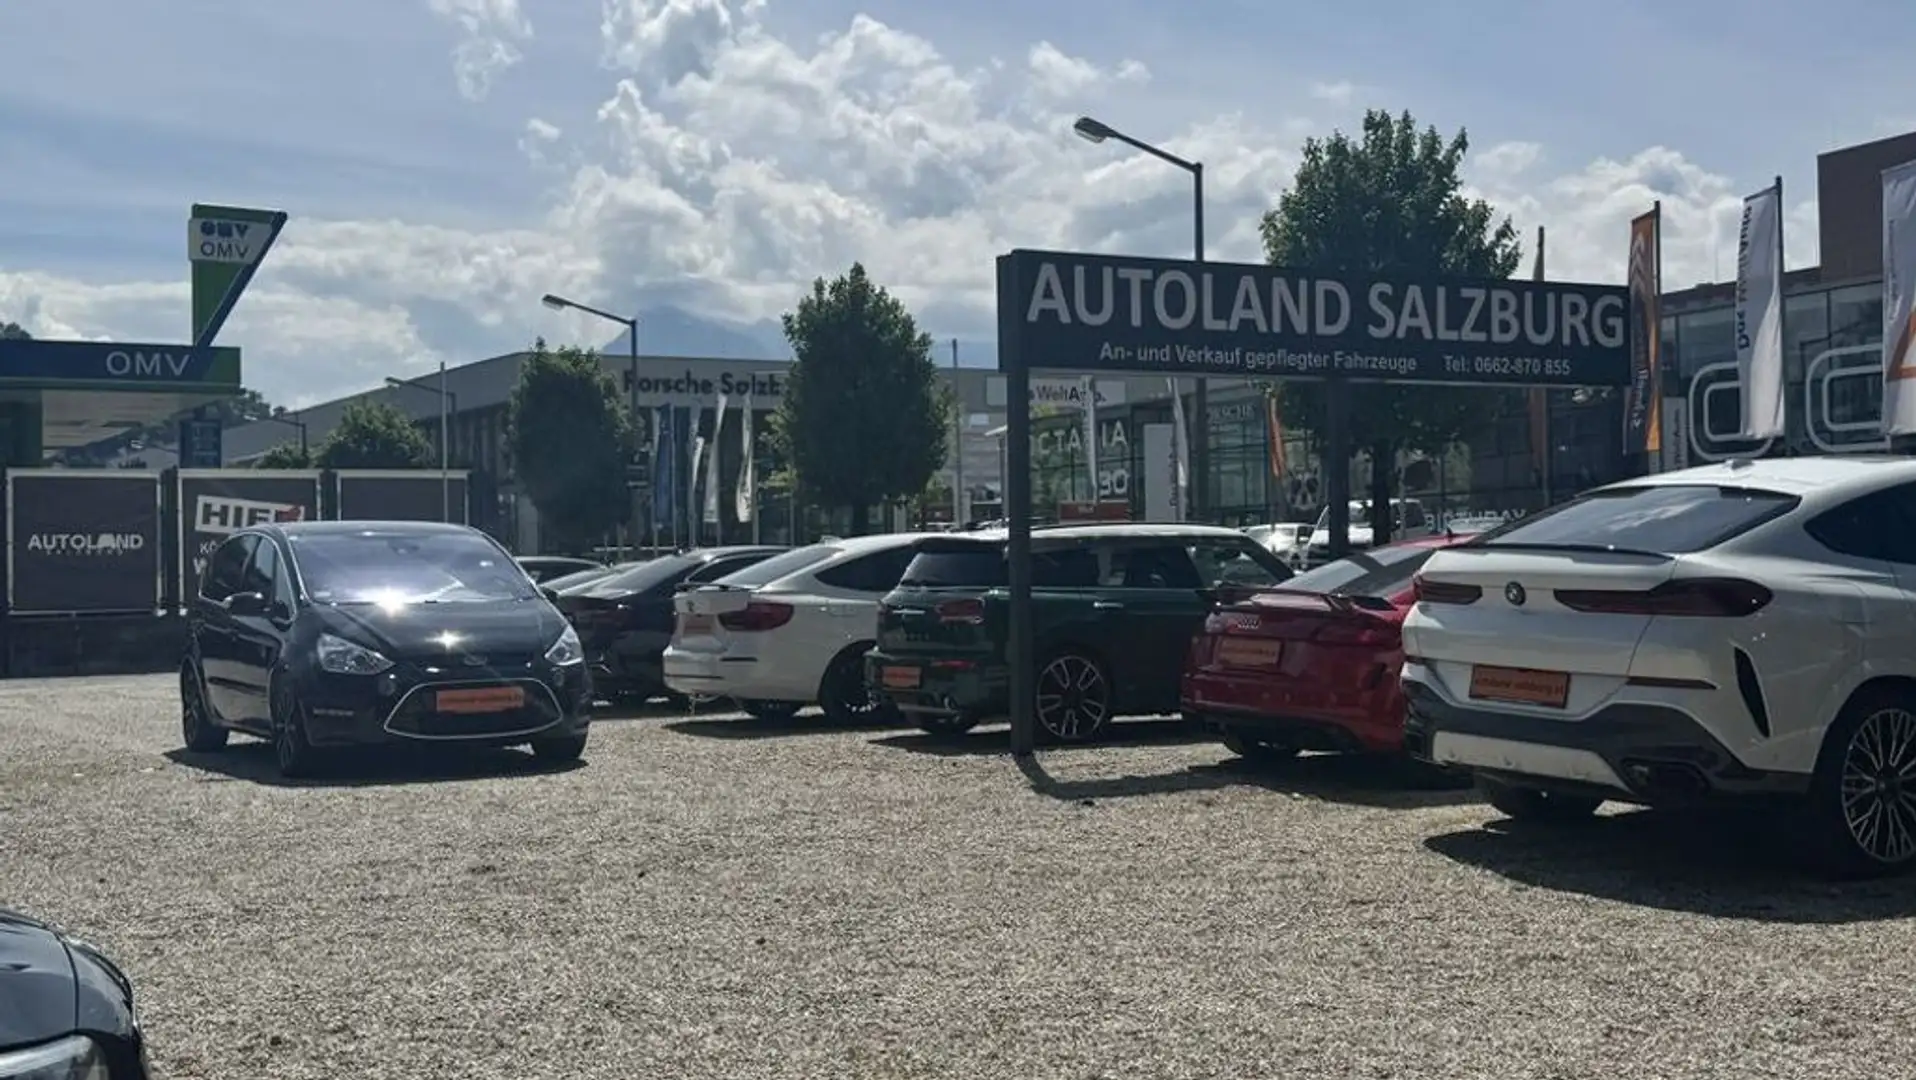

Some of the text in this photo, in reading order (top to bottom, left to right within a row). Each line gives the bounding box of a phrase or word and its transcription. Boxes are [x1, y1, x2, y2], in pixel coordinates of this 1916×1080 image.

[200, 241, 249, 258] OMV
[1027, 263, 1626, 348] AUTOLAND SALZBURG
[106, 350, 192, 377] OMV
[1099, 342, 1417, 372] An- und Verkauf gepflegter Fahrzeuge
[1474, 356, 1542, 375] 0662-870
[720, 372, 782, 397] Salzb
[1030, 419, 1130, 456] CTAIA
[27, 533, 144, 551] AUTOLAND
